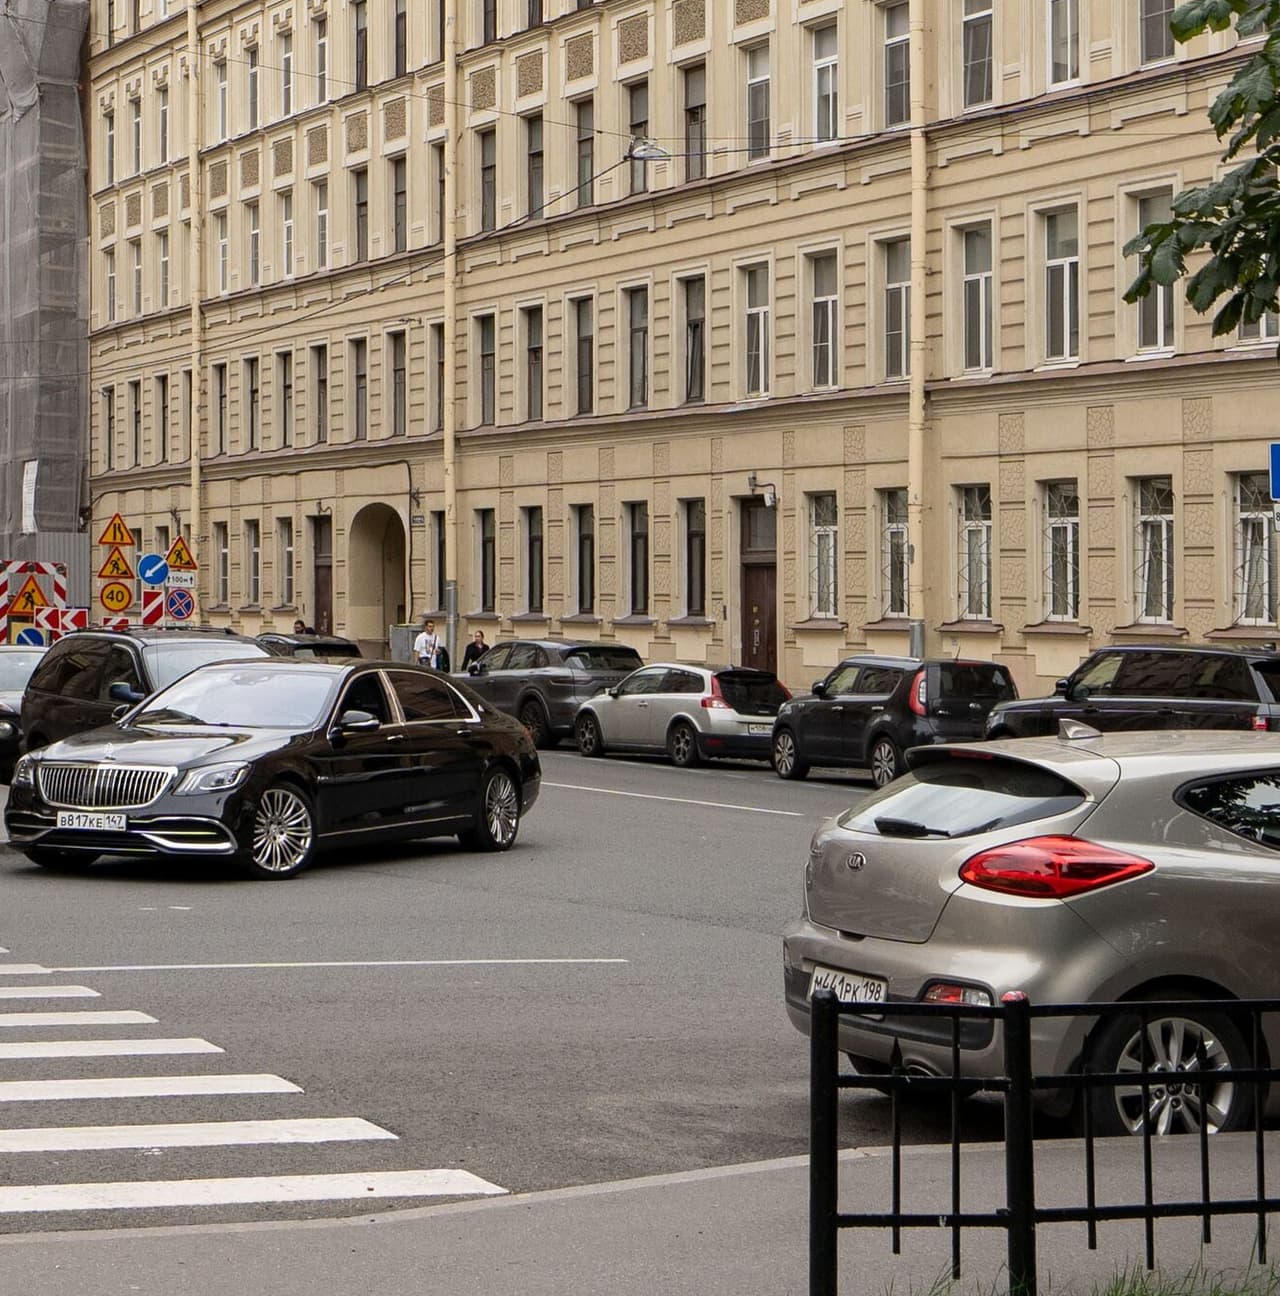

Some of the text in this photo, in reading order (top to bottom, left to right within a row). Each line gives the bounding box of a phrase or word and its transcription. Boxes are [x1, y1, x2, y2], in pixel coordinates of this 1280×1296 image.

[106, 589, 125, 603] 40
[105, 815, 123, 826] 147
[863, 980, 882, 1001] 198
